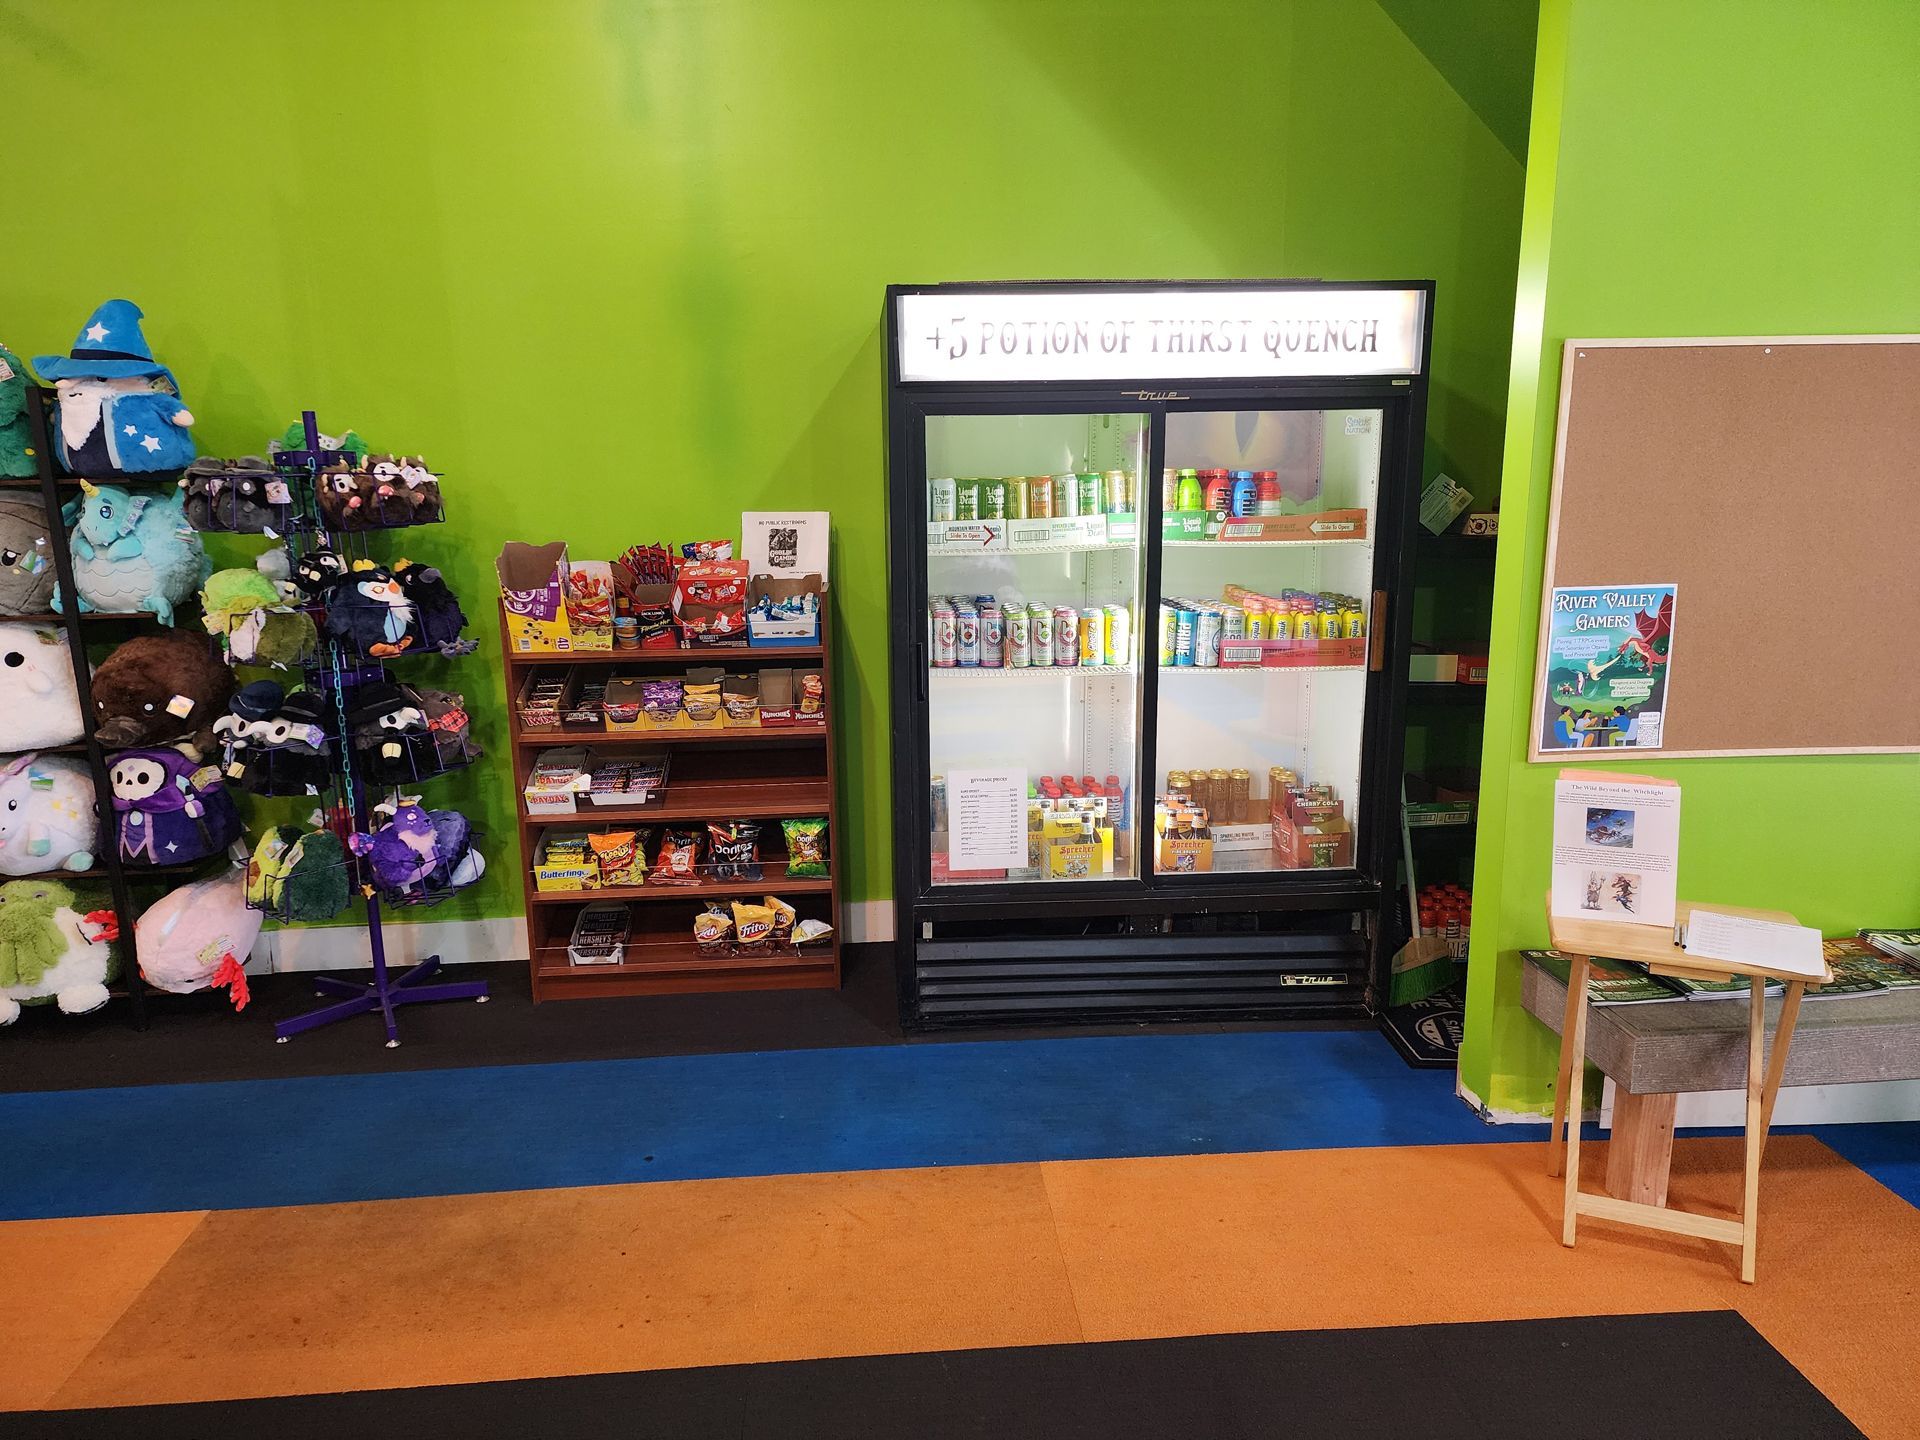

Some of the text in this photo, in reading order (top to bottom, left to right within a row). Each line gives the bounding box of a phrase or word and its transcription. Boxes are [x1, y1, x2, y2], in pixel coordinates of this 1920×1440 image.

[926, 317, 1379, 360] +5 POTION OF THIRST QUENCH
[1128, 389, 1184, 401] true
[934, 487, 951, 499] Liqui
[1215, 487, 1232, 510] PRI
[935, 496, 951, 505] Dea
[1242, 488, 1257, 517] PRI
[1183, 517, 1201, 526] Liquid
[1183, 524, 1201, 533] Death
[770, 549, 793, 558] GOBLIN
[774, 555, 798, 563] GAMING
[1555, 592, 1656, 612] RIVER VALLEY
[1570, 613, 1631, 633] GAMERS
[1252, 621, 1260, 640] squik
[1278, 621, 1286, 640] squik
[557, 637, 569, 649] 40
[1176, 622, 1192, 657] PRIME
[761, 709, 790, 719] MUNCHIES
[795, 711, 825, 720] MUNCHIES
[1598, 785, 1620, 793] Beyond
[1633, 788, 1664, 796] Witchlight
[531, 794, 566, 804] PAYDAY
[715, 842, 753, 855] Doritos
[1170, 840, 1205, 848] Sprecher
[1060, 845, 1095, 855] Sprecher
[540, 869, 589, 880] Butterfing
[740, 922, 769, 937] Fritos
[579, 934, 612, 945] HERSHEY'S
